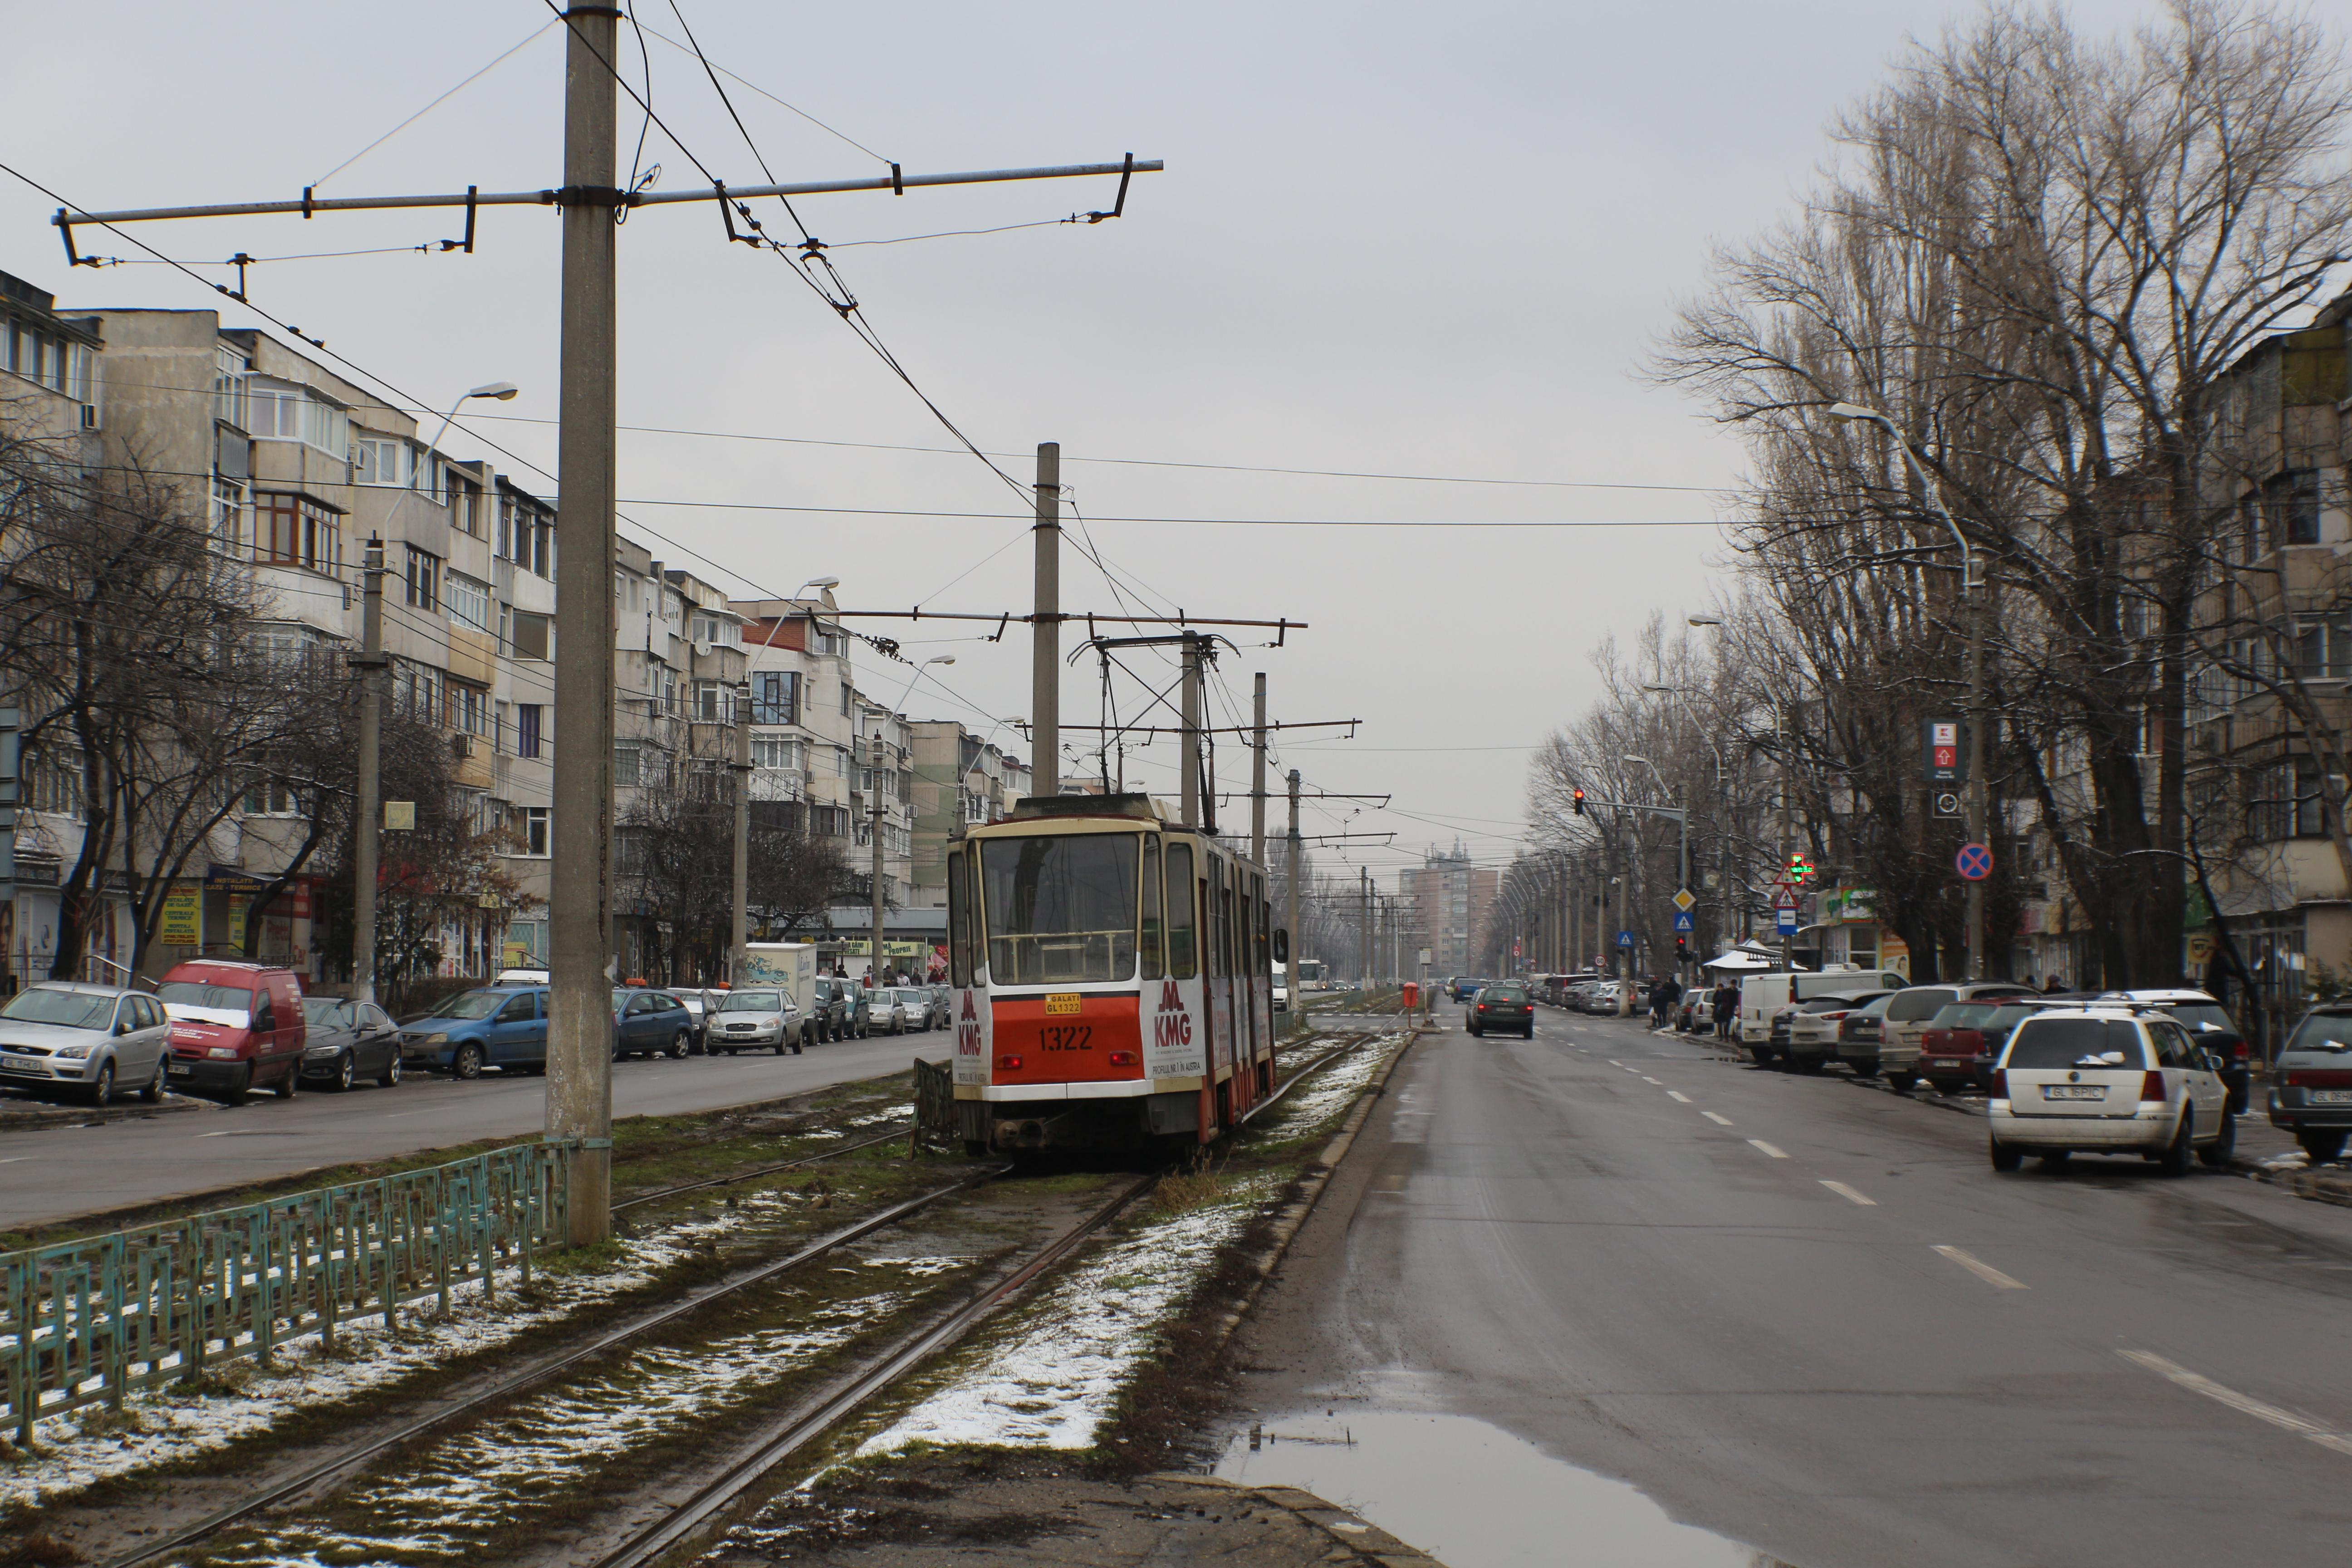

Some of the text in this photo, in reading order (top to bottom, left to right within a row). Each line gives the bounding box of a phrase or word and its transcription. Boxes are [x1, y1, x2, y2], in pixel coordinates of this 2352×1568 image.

[888, 946, 911, 955] PROPRIE
[1058, 1003, 1079, 1012] 1322
[1154, 1013, 1191, 1048] KMG
[959, 1023, 981, 1056] KMG
[1039, 1026, 1093, 1051] 1322
[1152, 1064, 1170, 1075] PROFILUL
[1186, 1061, 1201, 1072] AUSTRIA
[2053, 1088, 2067, 1097] GL
[2317, 1092, 2328, 1101] GL
